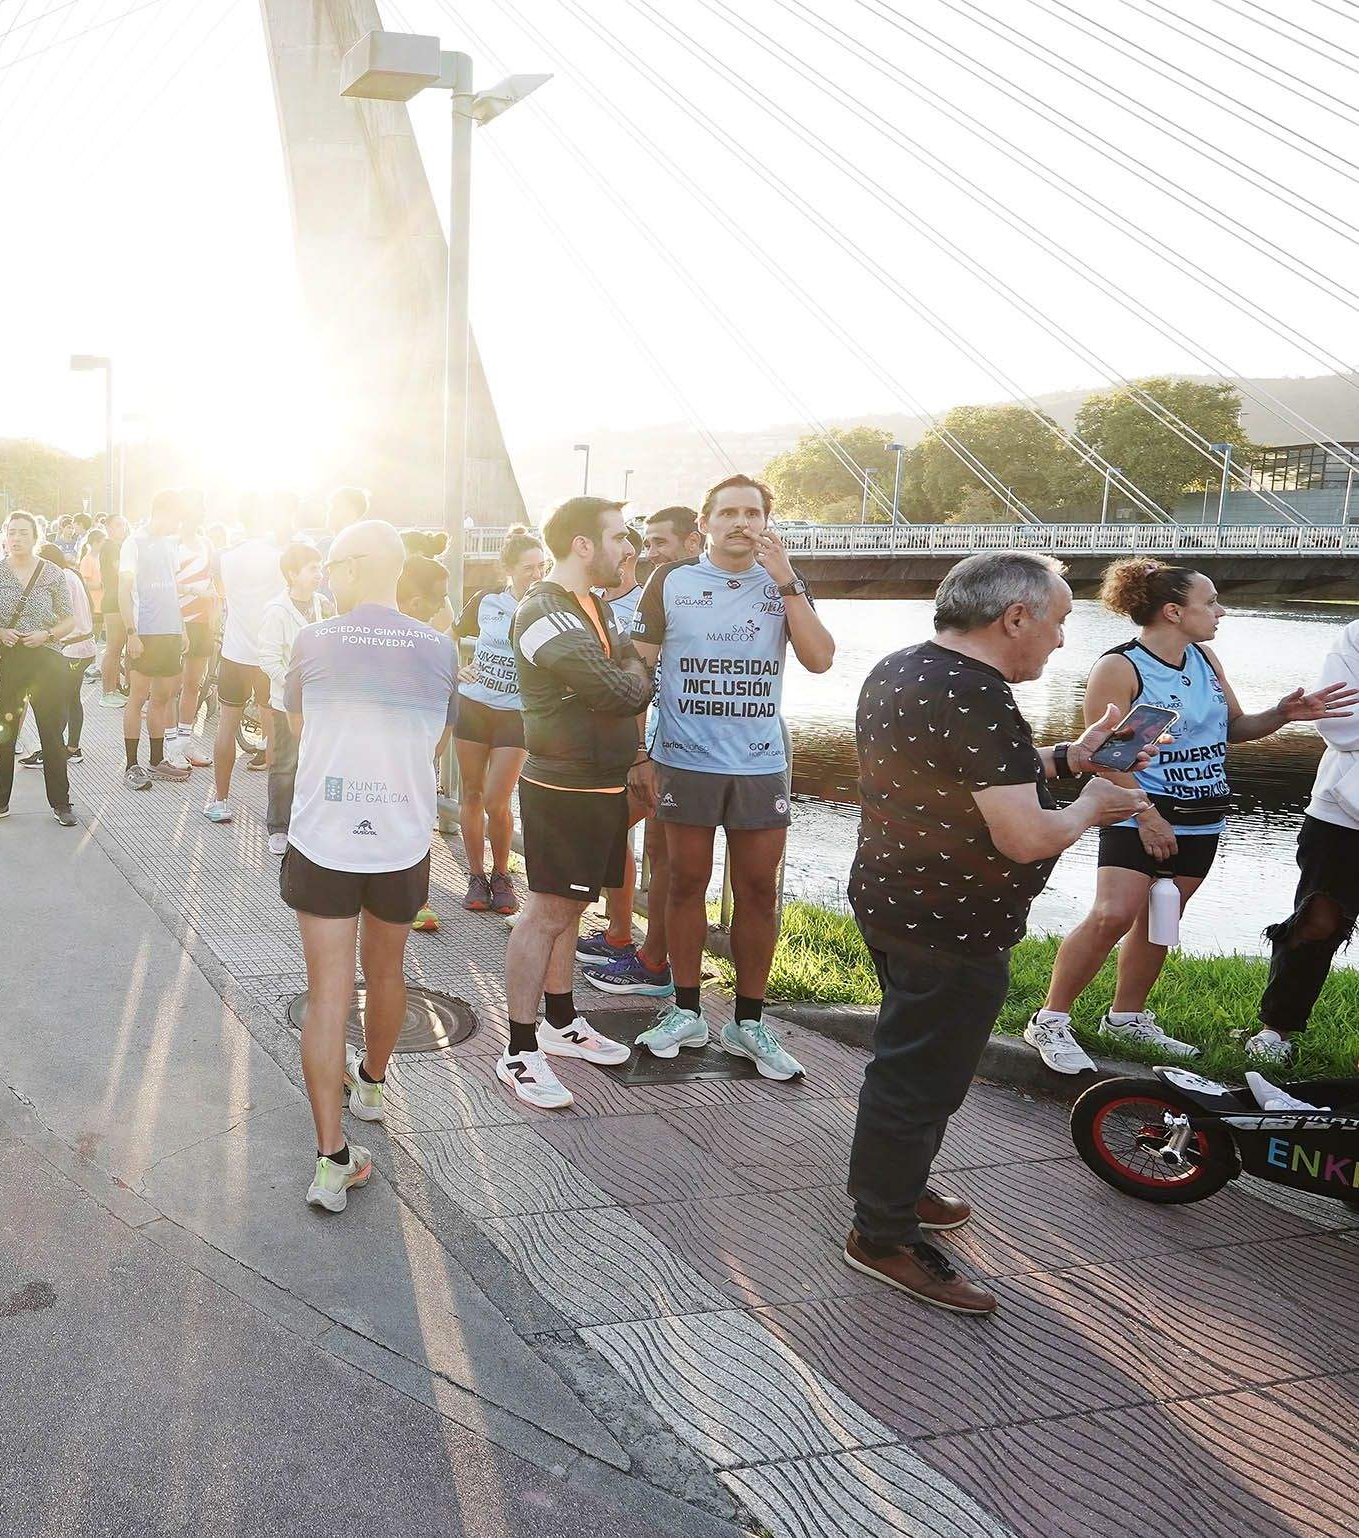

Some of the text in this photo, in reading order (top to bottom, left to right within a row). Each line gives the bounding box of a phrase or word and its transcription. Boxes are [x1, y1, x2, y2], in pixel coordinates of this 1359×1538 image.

[315, 625, 441, 645] SOCIEDAD GIMNÁSTICA
[341, 635, 416, 649] PONTEVEDRA
[705, 633, 755, 642] MARCOS
[679, 657, 780, 676] DIVERSIDAD
[682, 677, 772, 697] INCLUSIÓN
[677, 698, 776, 718] VISIBILIDAD
[1163, 762, 1224, 782] INCLUS
[347, 780, 388, 792] XUNTA
[346, 791, 410, 804] DE GALICIA
